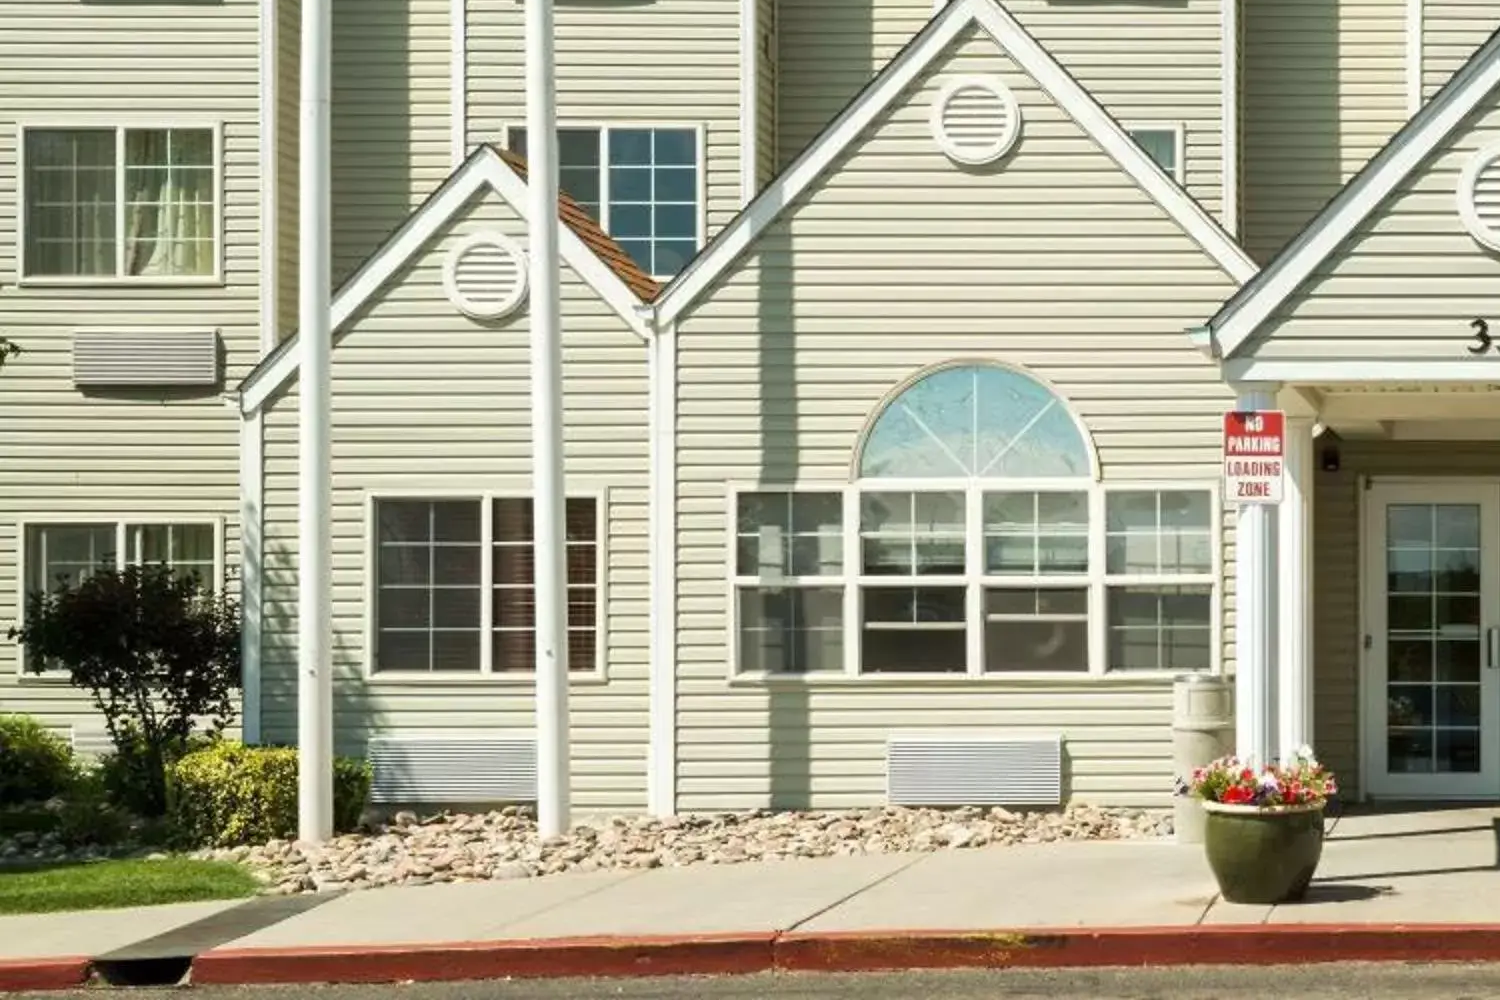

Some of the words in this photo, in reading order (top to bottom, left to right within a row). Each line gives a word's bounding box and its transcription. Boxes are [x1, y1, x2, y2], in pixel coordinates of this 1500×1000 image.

[1245, 415, 1264, 433] NO
[1227, 436, 1280, 452] PARKING
[1227, 461, 1280, 477] LOADING
[1237, 481, 1270, 497] ZONE
